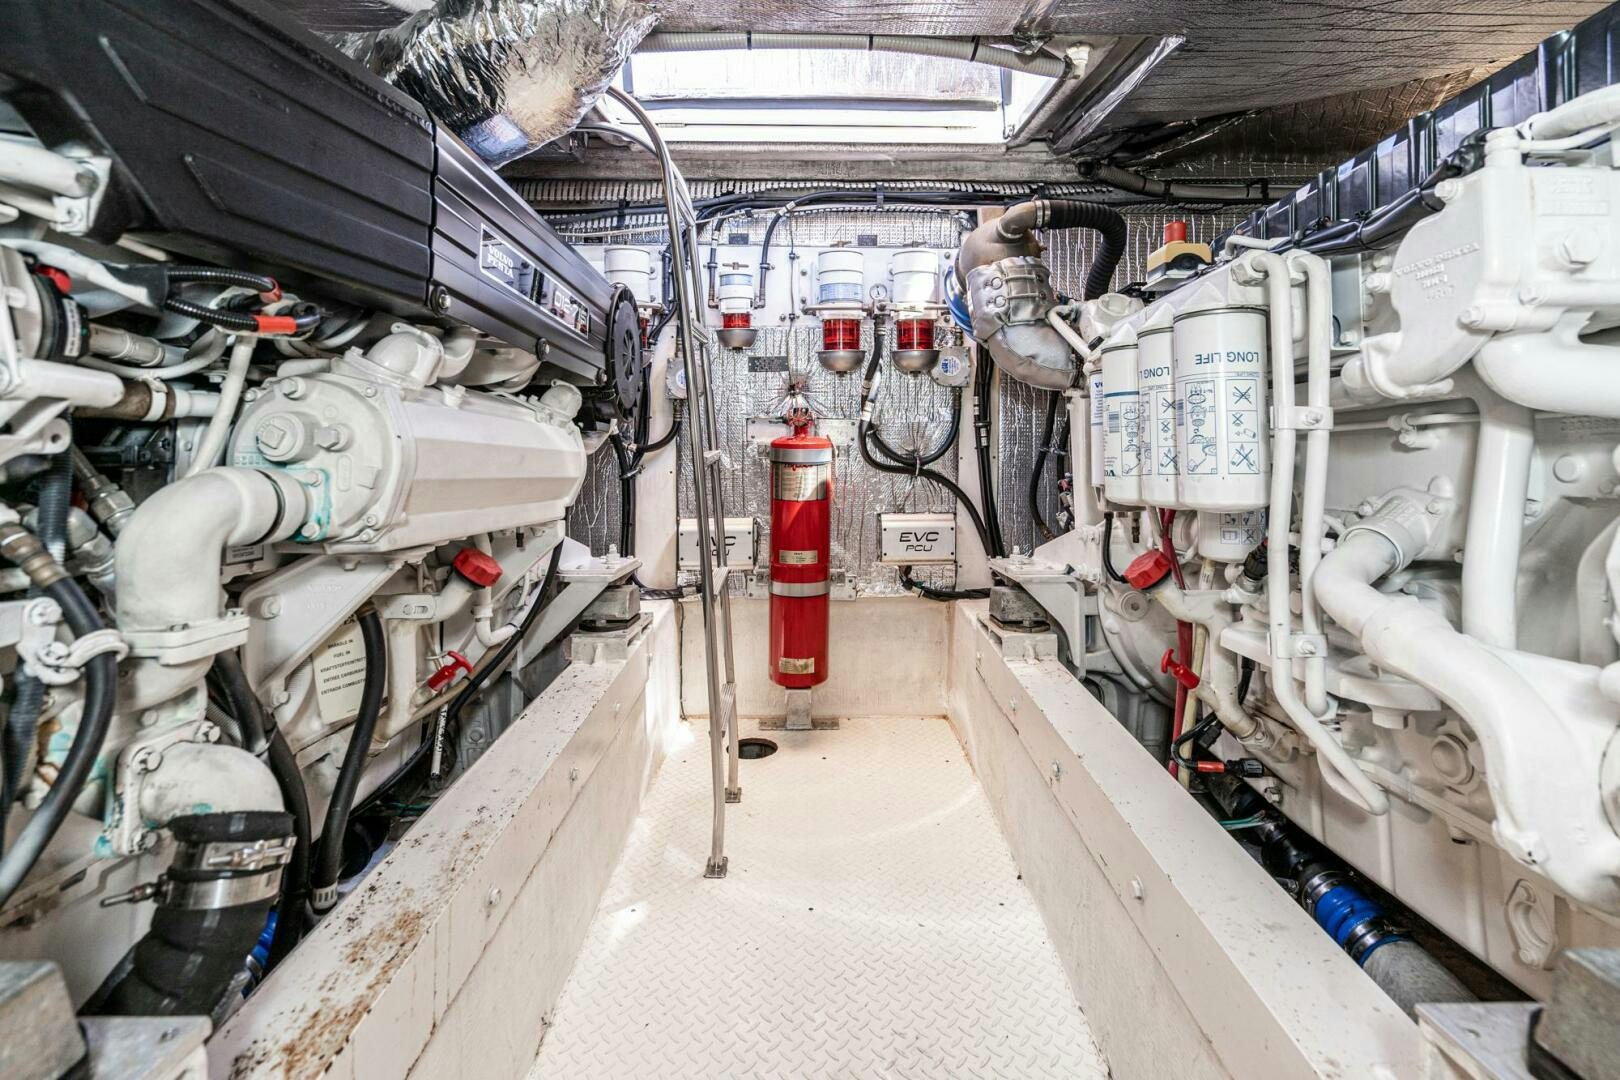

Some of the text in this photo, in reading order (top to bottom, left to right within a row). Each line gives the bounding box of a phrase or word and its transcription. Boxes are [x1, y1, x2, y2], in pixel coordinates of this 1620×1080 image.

[488, 244, 514, 269] VOLVO
[487, 253, 514, 279] PENTA
[1195, 351, 1259, 365] LONG LIFE
[1144, 366, 1170, 379] LONG
[899, 531, 940, 542] EVC
[905, 544, 933, 552] PCU
